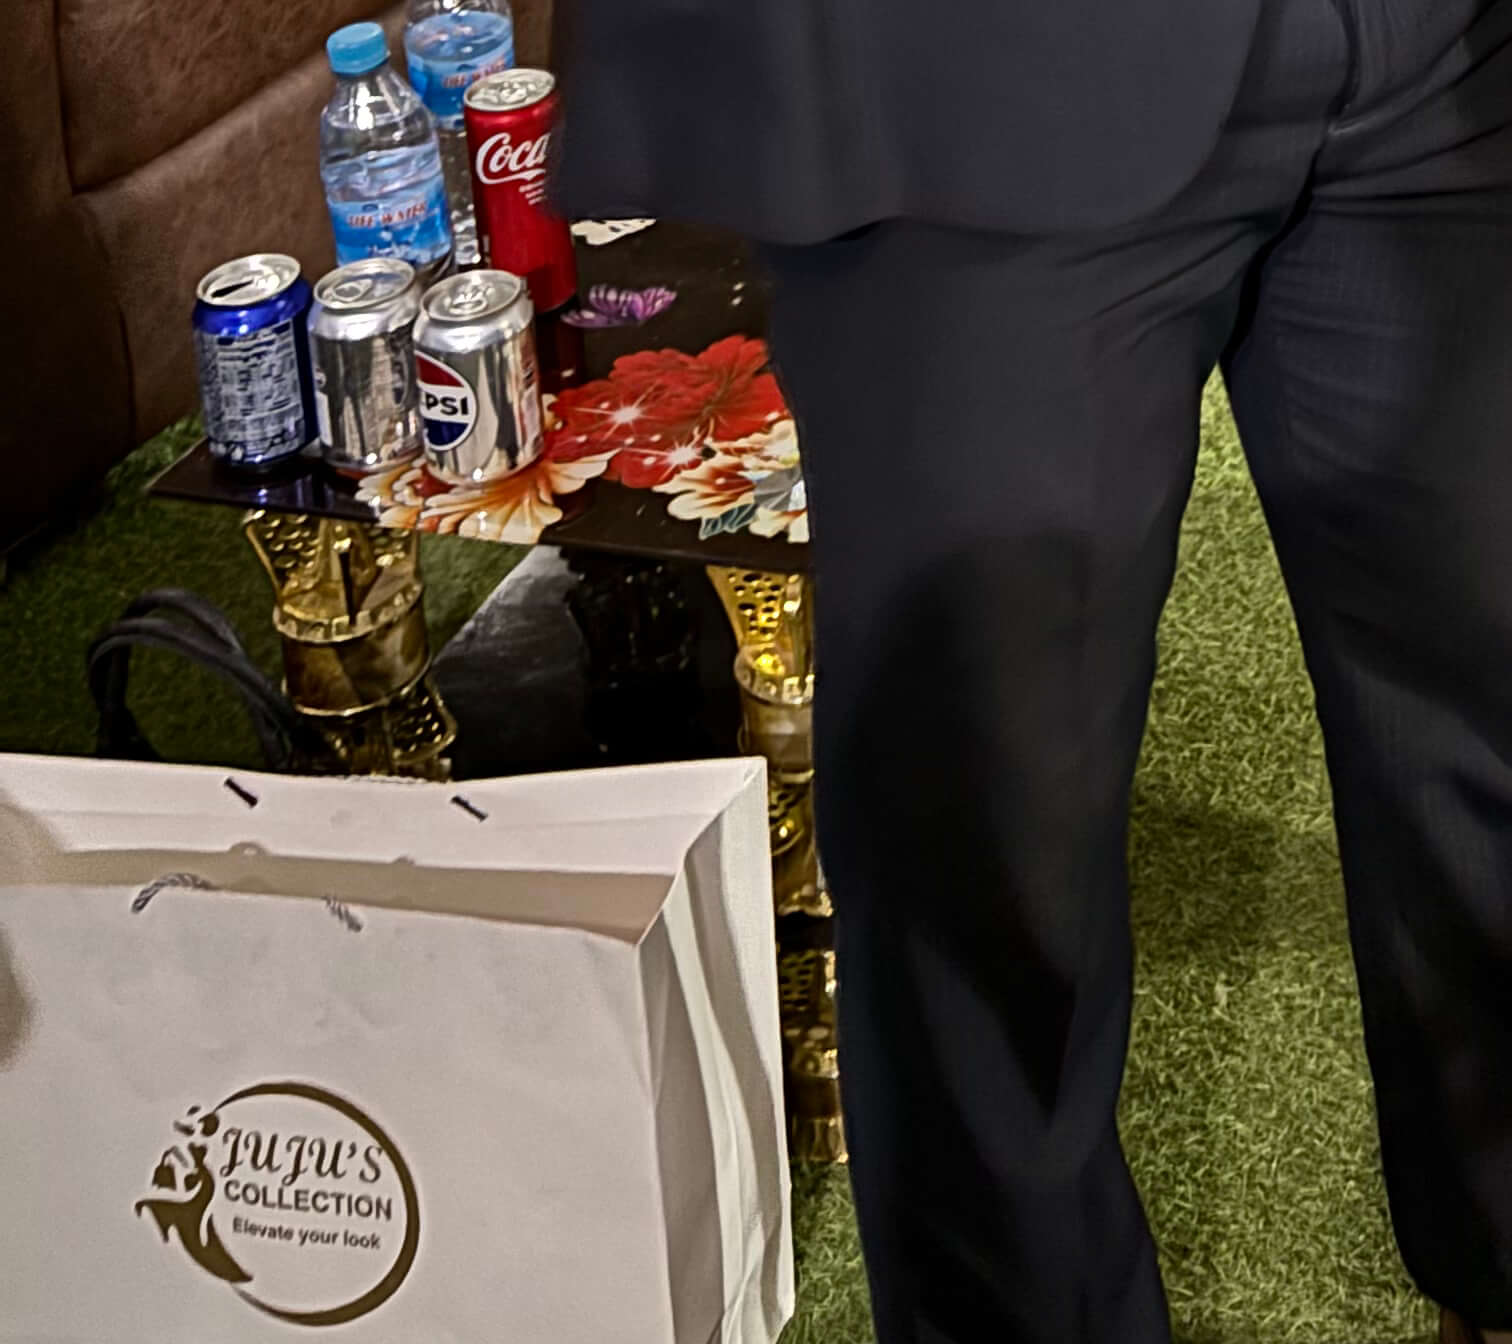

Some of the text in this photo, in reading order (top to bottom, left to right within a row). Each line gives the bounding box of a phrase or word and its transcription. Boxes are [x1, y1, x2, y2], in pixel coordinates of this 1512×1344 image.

[425, 392, 469, 416] PSI
[219, 1126, 384, 1186] JUJU'S
[223, 1179, 393, 1221] COLLECTION
[232, 1216, 382, 1250] Elevate your look
